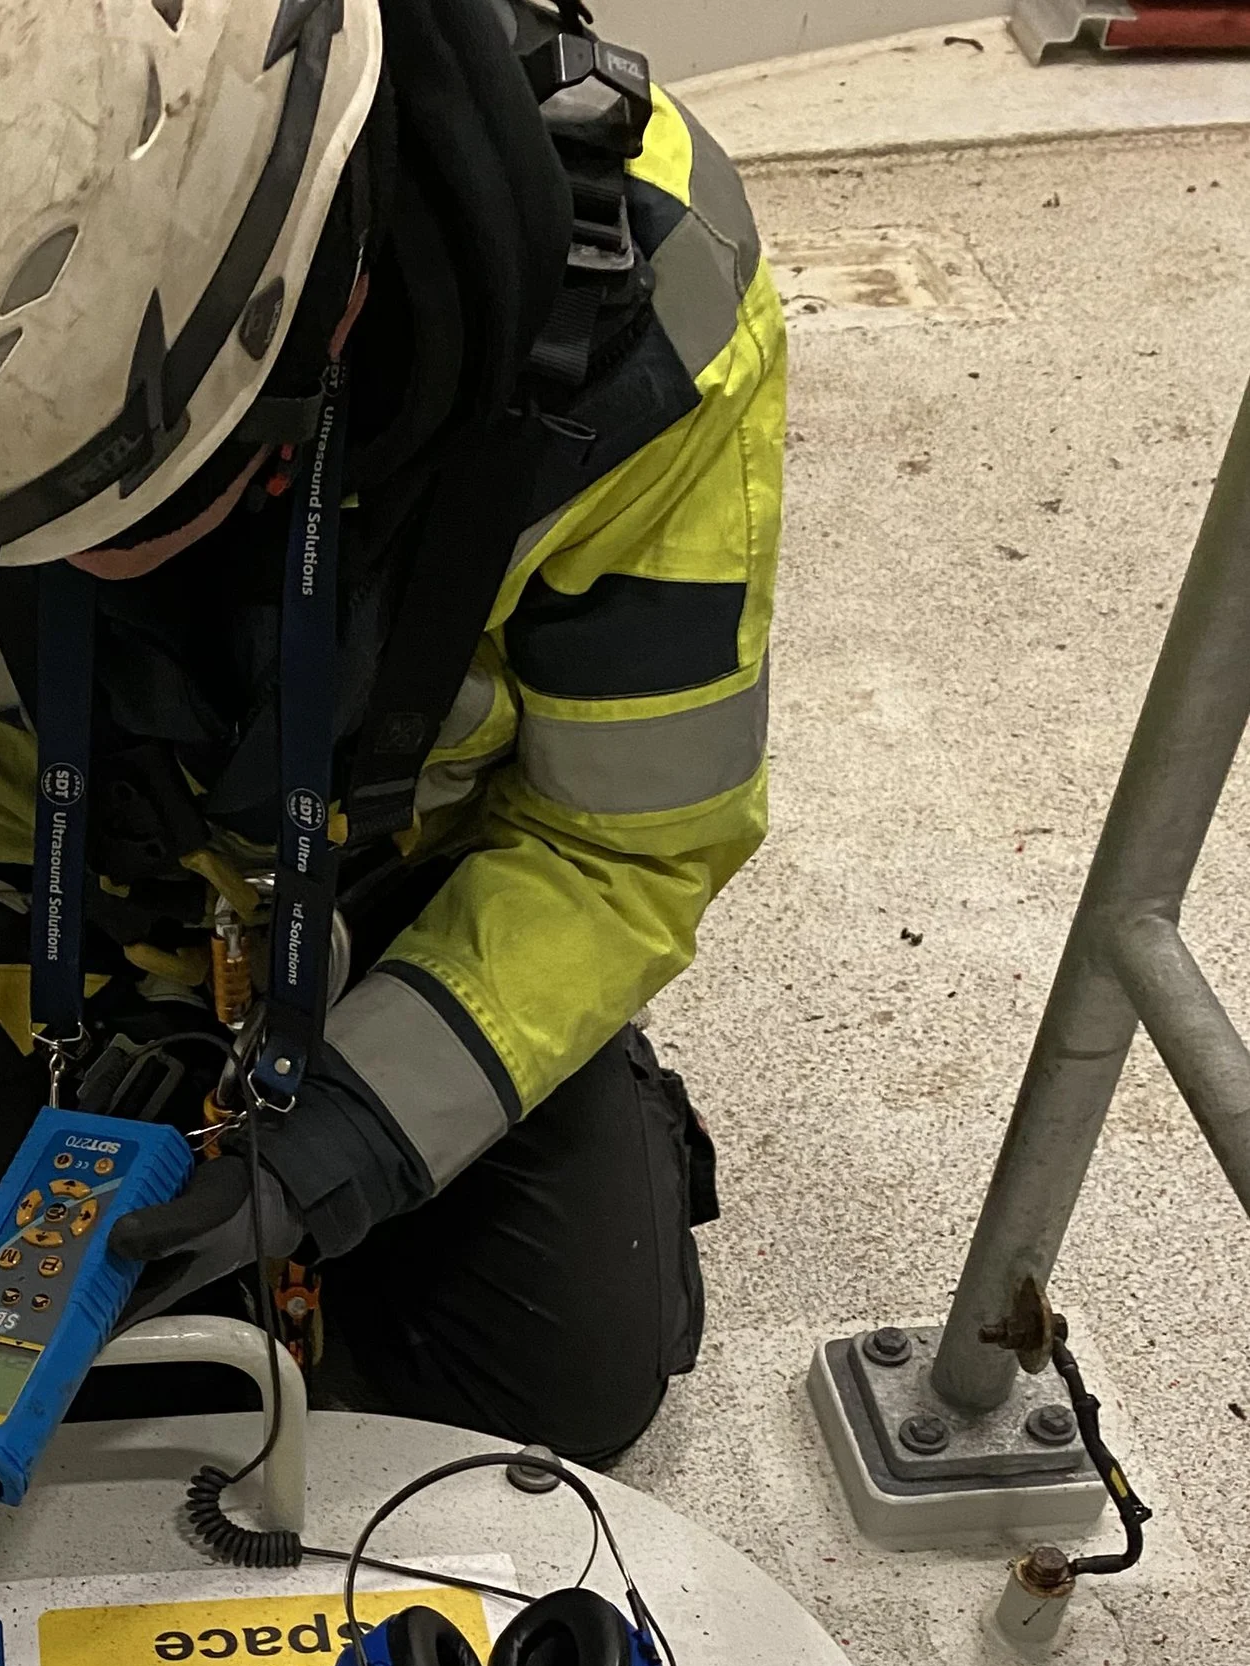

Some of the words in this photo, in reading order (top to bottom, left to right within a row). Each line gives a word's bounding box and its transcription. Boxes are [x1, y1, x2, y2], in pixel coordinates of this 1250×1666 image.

[309, 405, 334, 508] Ultrasound
[302, 512, 321, 596] Solutions
[55, 770, 70, 799] SDT
[299, 795, 312, 825] SDT
[50, 811, 67, 894] Ultrasound
[47, 897, 62, 961] Solutions
[288, 920, 303, 986] Solutions
[65, 1135, 122, 1155] SDT270
